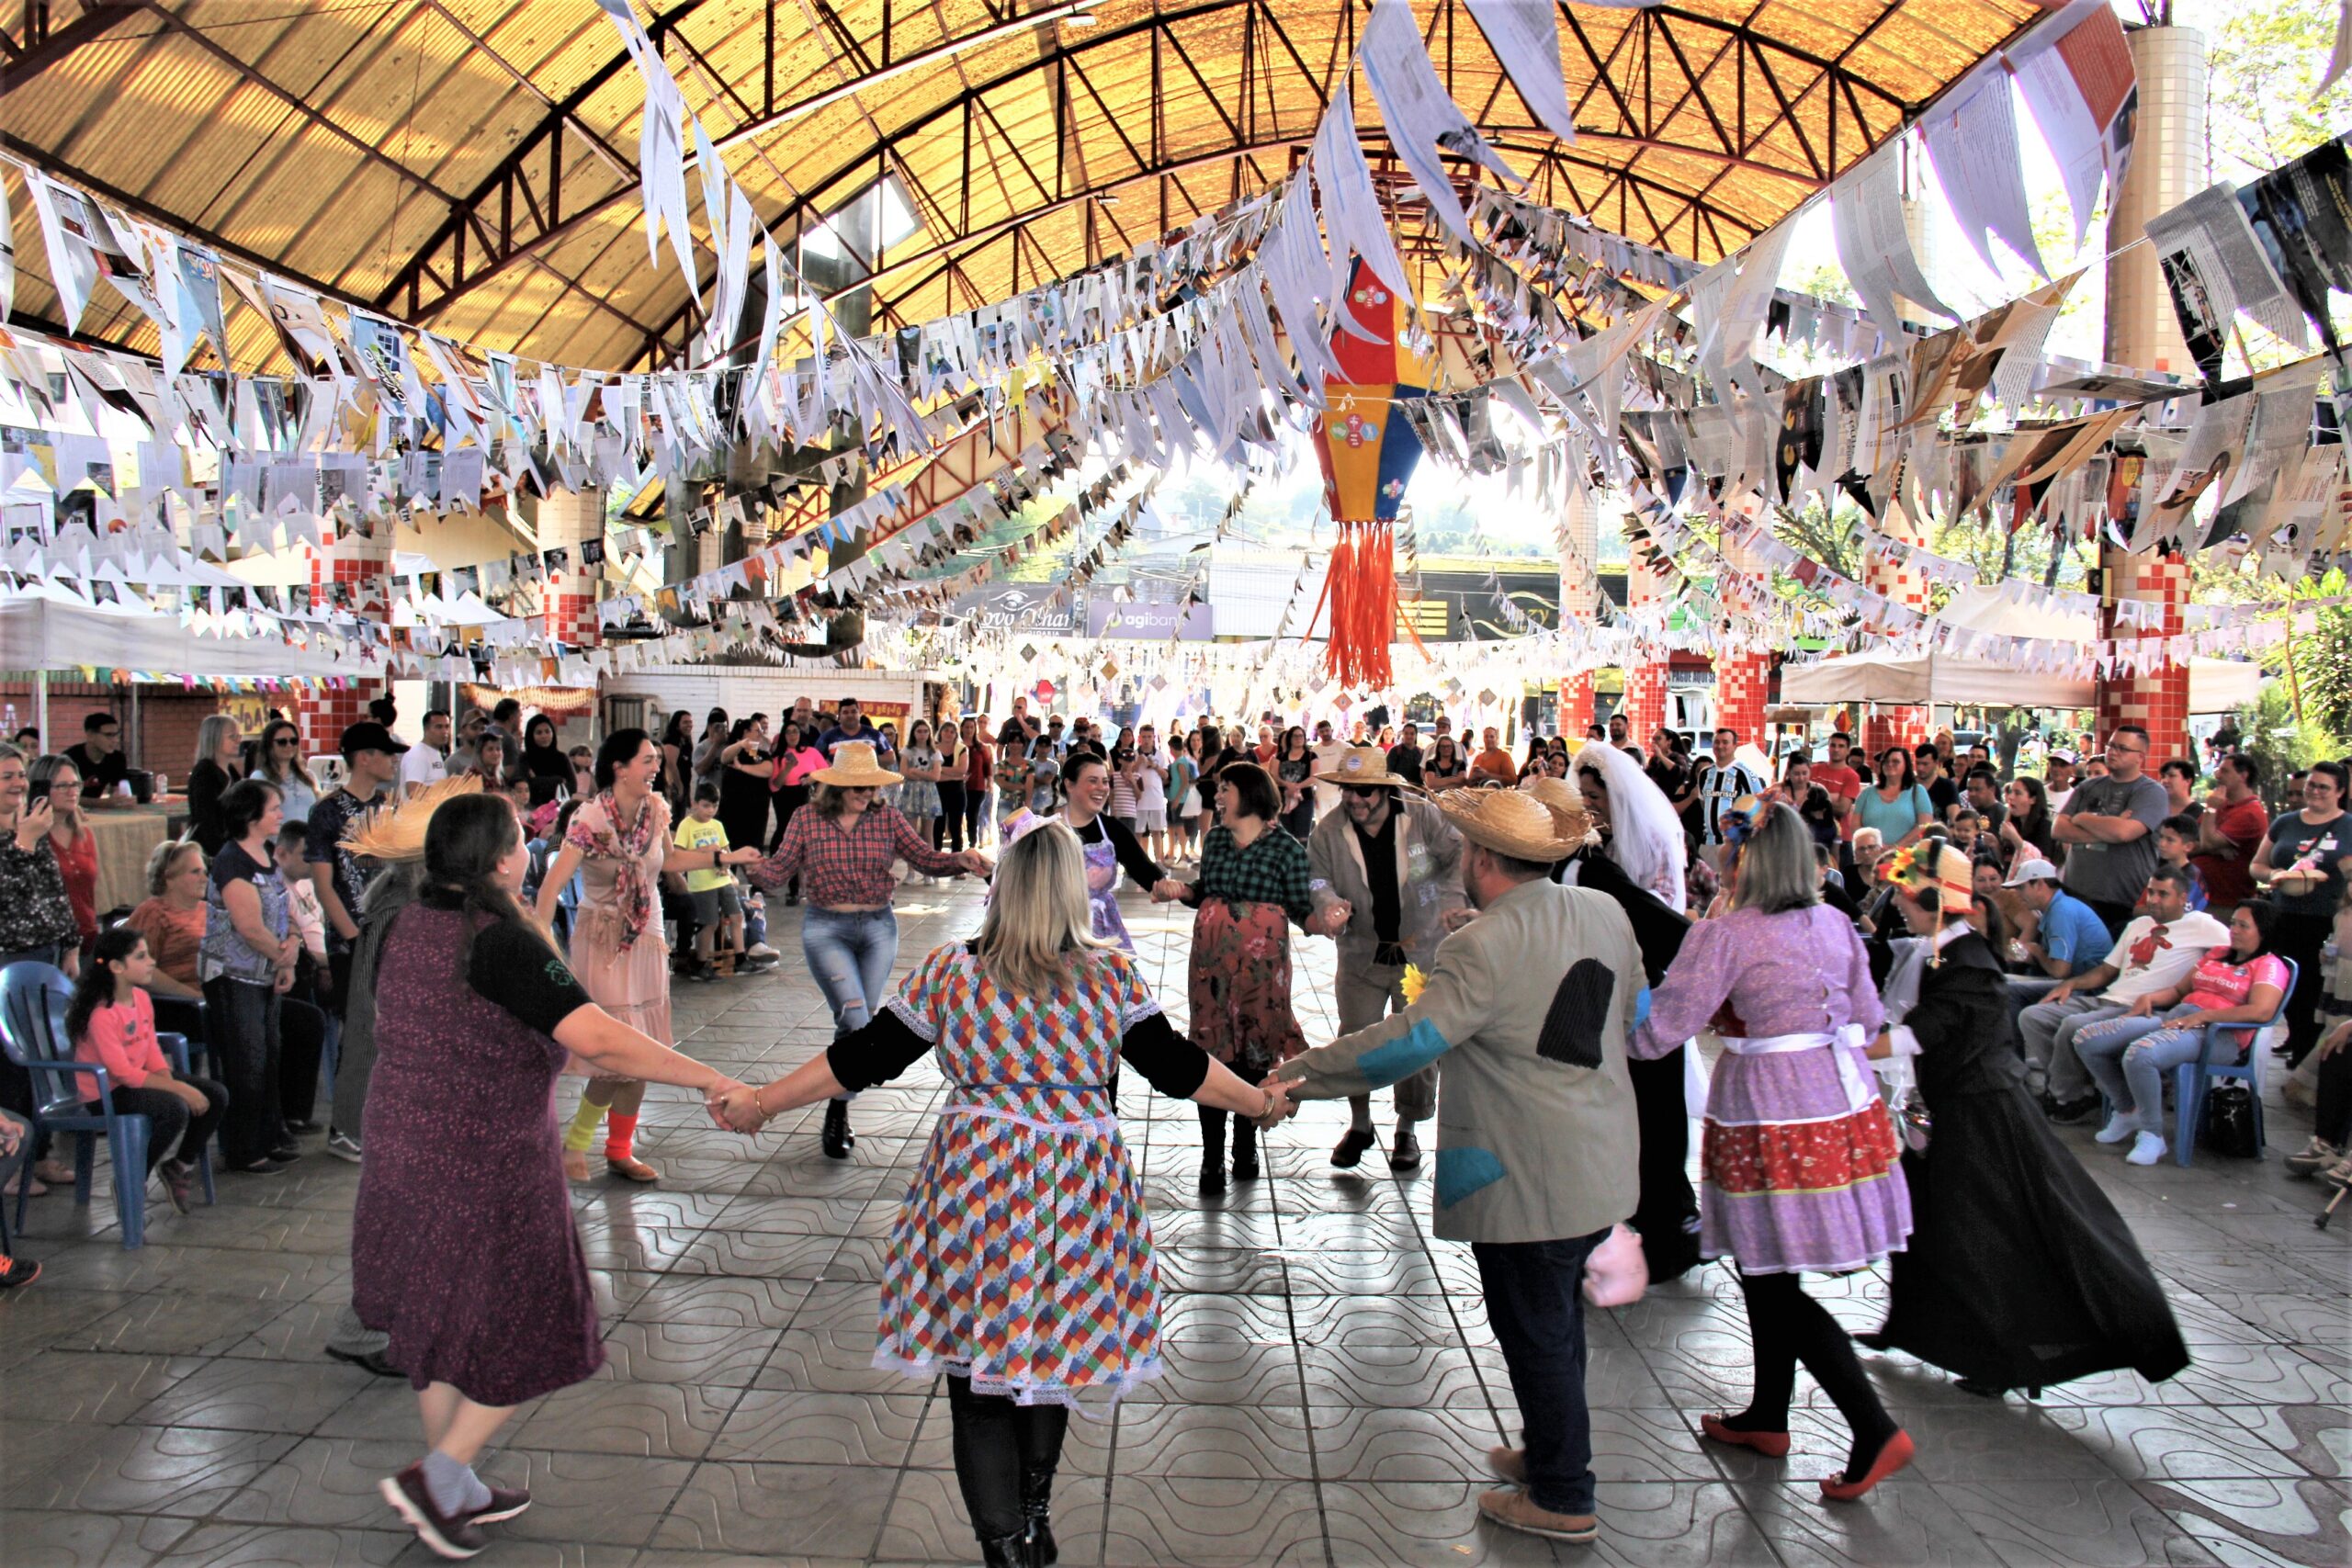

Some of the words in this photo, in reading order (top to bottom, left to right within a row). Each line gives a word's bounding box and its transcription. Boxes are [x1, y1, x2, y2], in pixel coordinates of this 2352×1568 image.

[1672, 671, 1691, 682] PAGUE
[1692, 671, 1708, 683] AQUI
[1706, 790, 1738, 798] Banrisul
[2195, 971, 2239, 990] Banrisul
